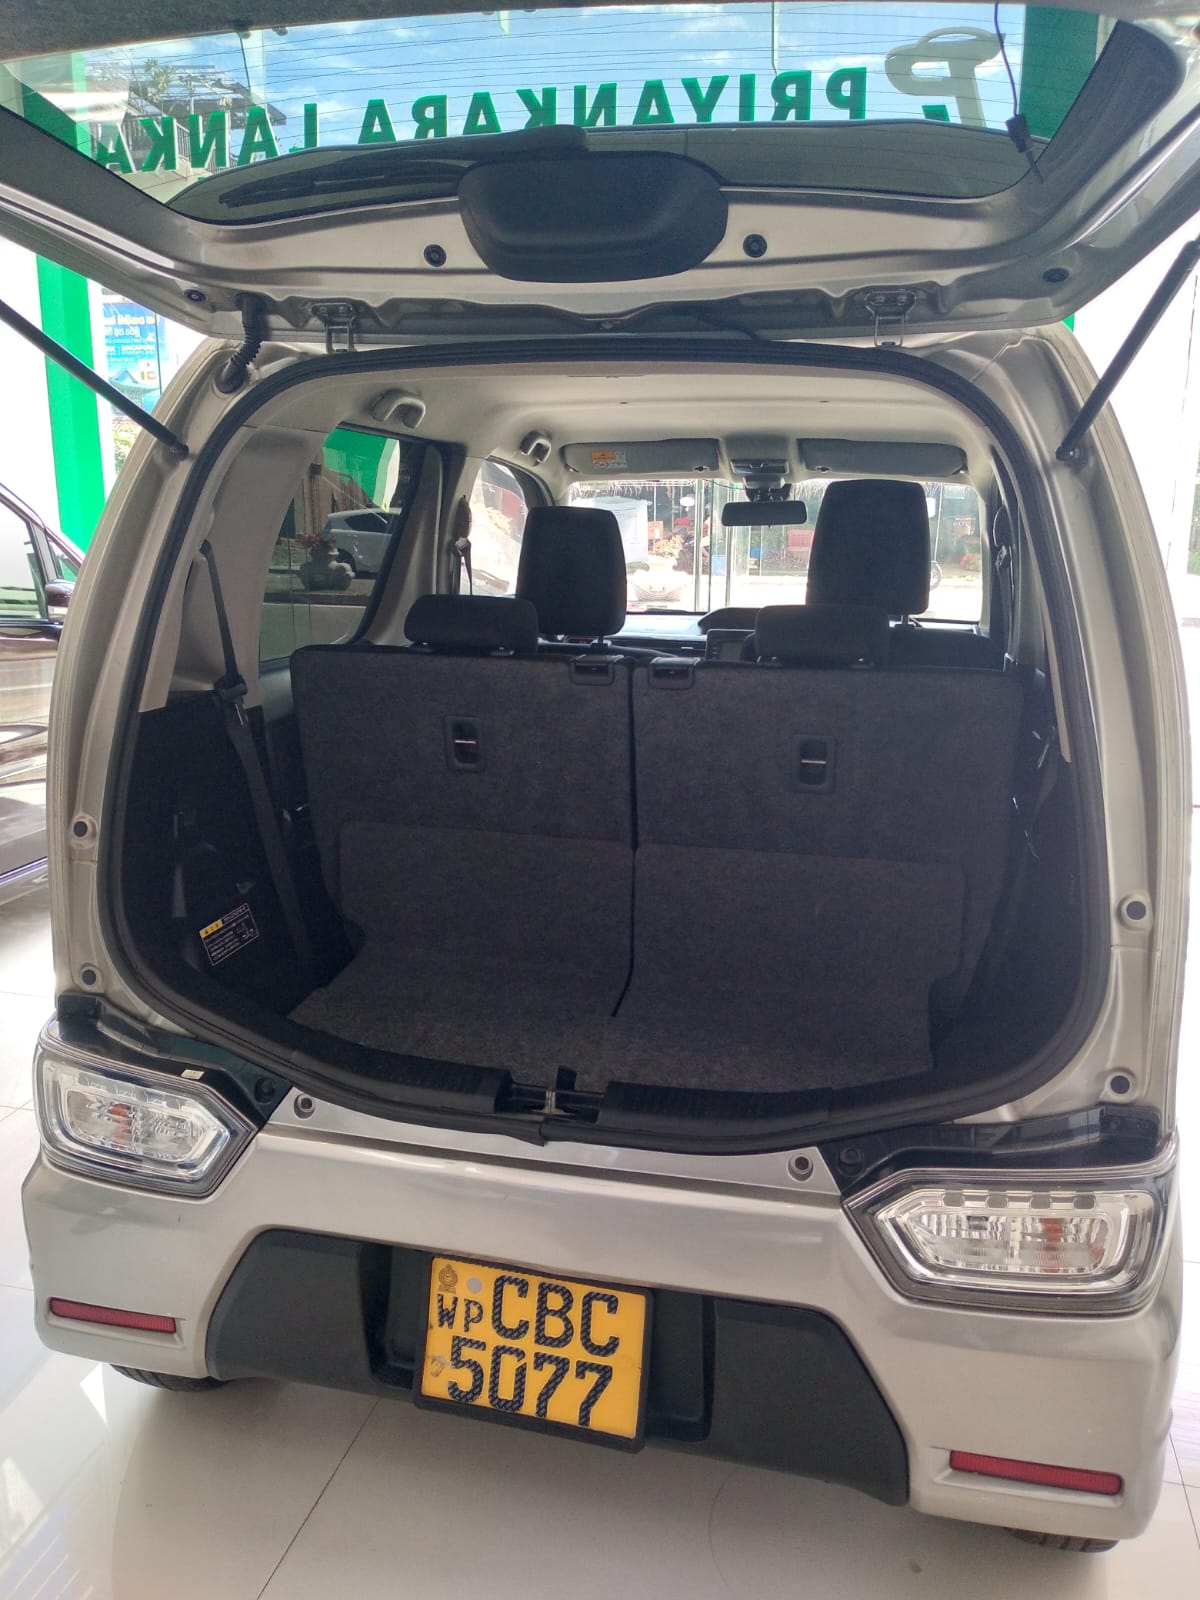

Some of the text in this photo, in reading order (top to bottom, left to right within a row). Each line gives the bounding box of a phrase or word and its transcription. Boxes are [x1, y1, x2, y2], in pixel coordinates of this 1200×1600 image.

[437, 1274, 620, 1357] WP CBC
[447, 1335, 613, 1427] 5077
